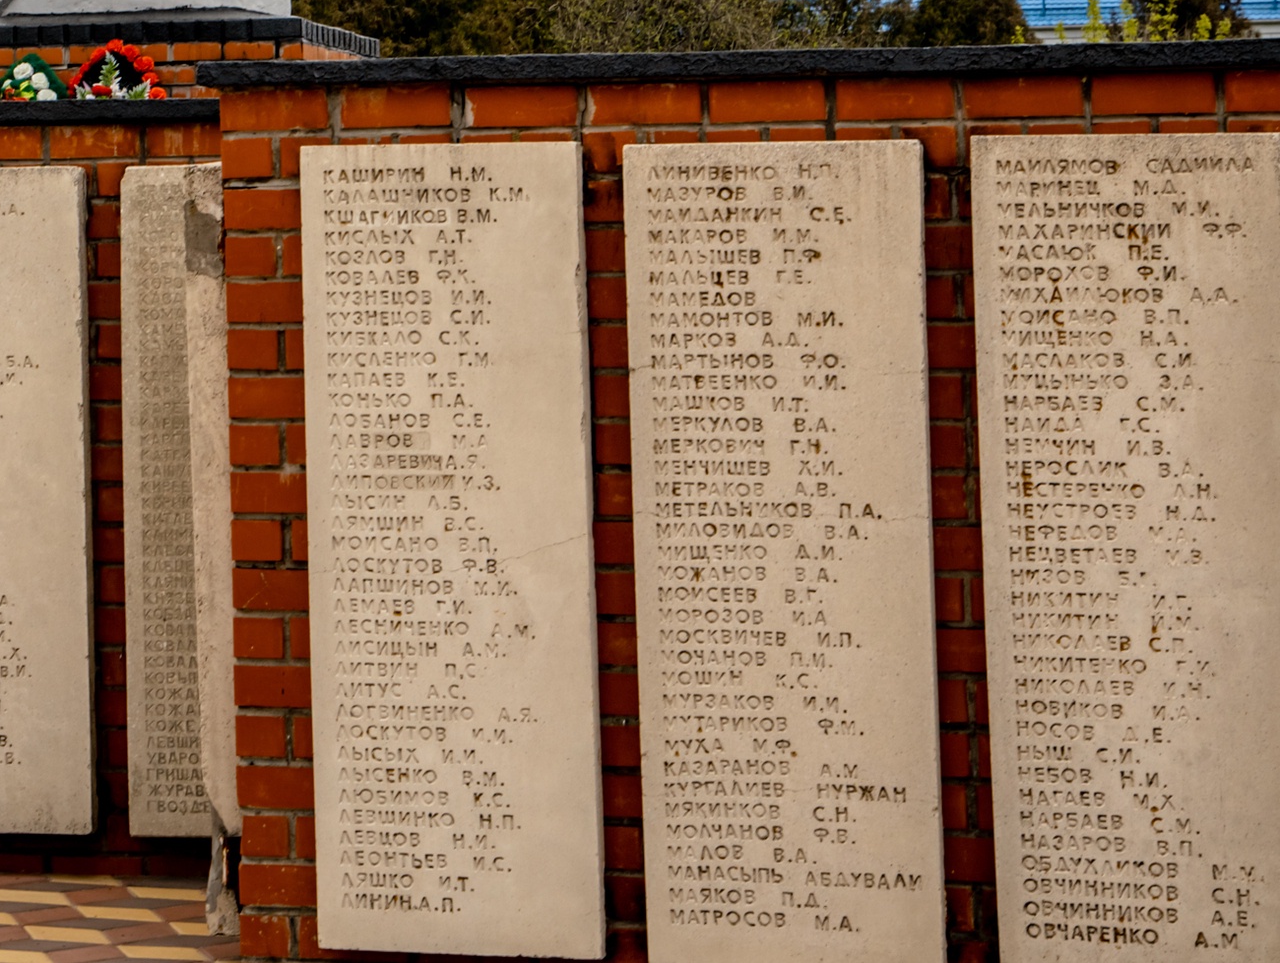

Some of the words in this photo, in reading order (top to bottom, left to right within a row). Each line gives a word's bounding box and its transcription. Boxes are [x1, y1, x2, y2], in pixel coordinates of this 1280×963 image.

[323, 167, 424, 183] КАШИРИН
[450, 167, 492, 181] Н.М.
[648, 229, 746, 244] МАКАРОВ
[773, 228, 818, 243] И.М.
[1202, 223, 1246, 239] Ф.Ф.
[326, 250, 405, 265] КОЗЛОВ
[429, 250, 464, 265] Г.Н.
[326, 270, 419, 286] КОВАЛЕВ
[437, 269, 475, 283] Ф.К.
[1000, 265, 1109, 283] МОРОХОВ
[1137, 266, 1187, 281] Ф.И.
[650, 291, 755, 306] МАМЕДОВ
[327, 310, 431, 326] КУЗНЕЦОВ
[450, 310, 490, 325] С.И.
[651, 311, 773, 327] МАМОНТОВ
[798, 311, 843, 327] М.И.
[649, 354, 774, 369] МАРТЫНОВ
[800, 354, 845, 368] Ф.О.
[327, 372, 405, 387] КАПАЕВ
[428, 372, 465, 387] К.Е.
[329, 393, 411, 407] КОНЬКО
[430, 393, 473, 407] П.А.
[330, 413, 430, 428] ЛОБАНОВ
[453, 413, 491, 428] С.Е.
[653, 416, 763, 432] МЕРКУЛОВ
[793, 418, 836, 432] В.А.
[1005, 438, 1095, 455] НЕМЧИН
[1127, 440, 1170, 455] И.В.
[1006, 461, 1126, 480] НЕРОСЛИК
[1158, 462, 1203, 478] В.А.
[655, 482, 764, 497] МЕТРАКОВ
[796, 482, 836, 497] А.В.
[658, 587, 757, 603] МОИСЕЕВ
[785, 589, 822, 604] В.Г.
[660, 629, 786, 647] МОСКВИЧЕВ
[818, 632, 862, 648] И.П.
[337, 640, 437, 657] ЛИСИЦЫН
[463, 642, 506, 658] А.М.
[1016, 721, 1094, 740] НОСОВ
[1122, 727, 1171, 743] Д.Е.
[1018, 767, 1092, 783] НЕБОВ
[1120, 771, 1167, 789] Н.И.
[1020, 811, 1123, 829] НАРБАЕВ
[1150, 817, 1200, 834] С.М.
[667, 824, 783, 840] МОЛЧАНОВ
[814, 828, 855, 844] Ф.В.
[1021, 834, 1126, 852] НАЗАРОВ
[1157, 840, 1202, 858] В.П.
[341, 850, 447, 869] ЛЕОНТЬЕВ
[473, 857, 511, 872] И.С.
[1023, 876, 1178, 903] ОВЧИННИКОВ
[1212, 888, 1259, 906] С.Н.
[670, 909, 785, 927] МАТРОСОВ
[815, 915, 860, 932] М.А.
